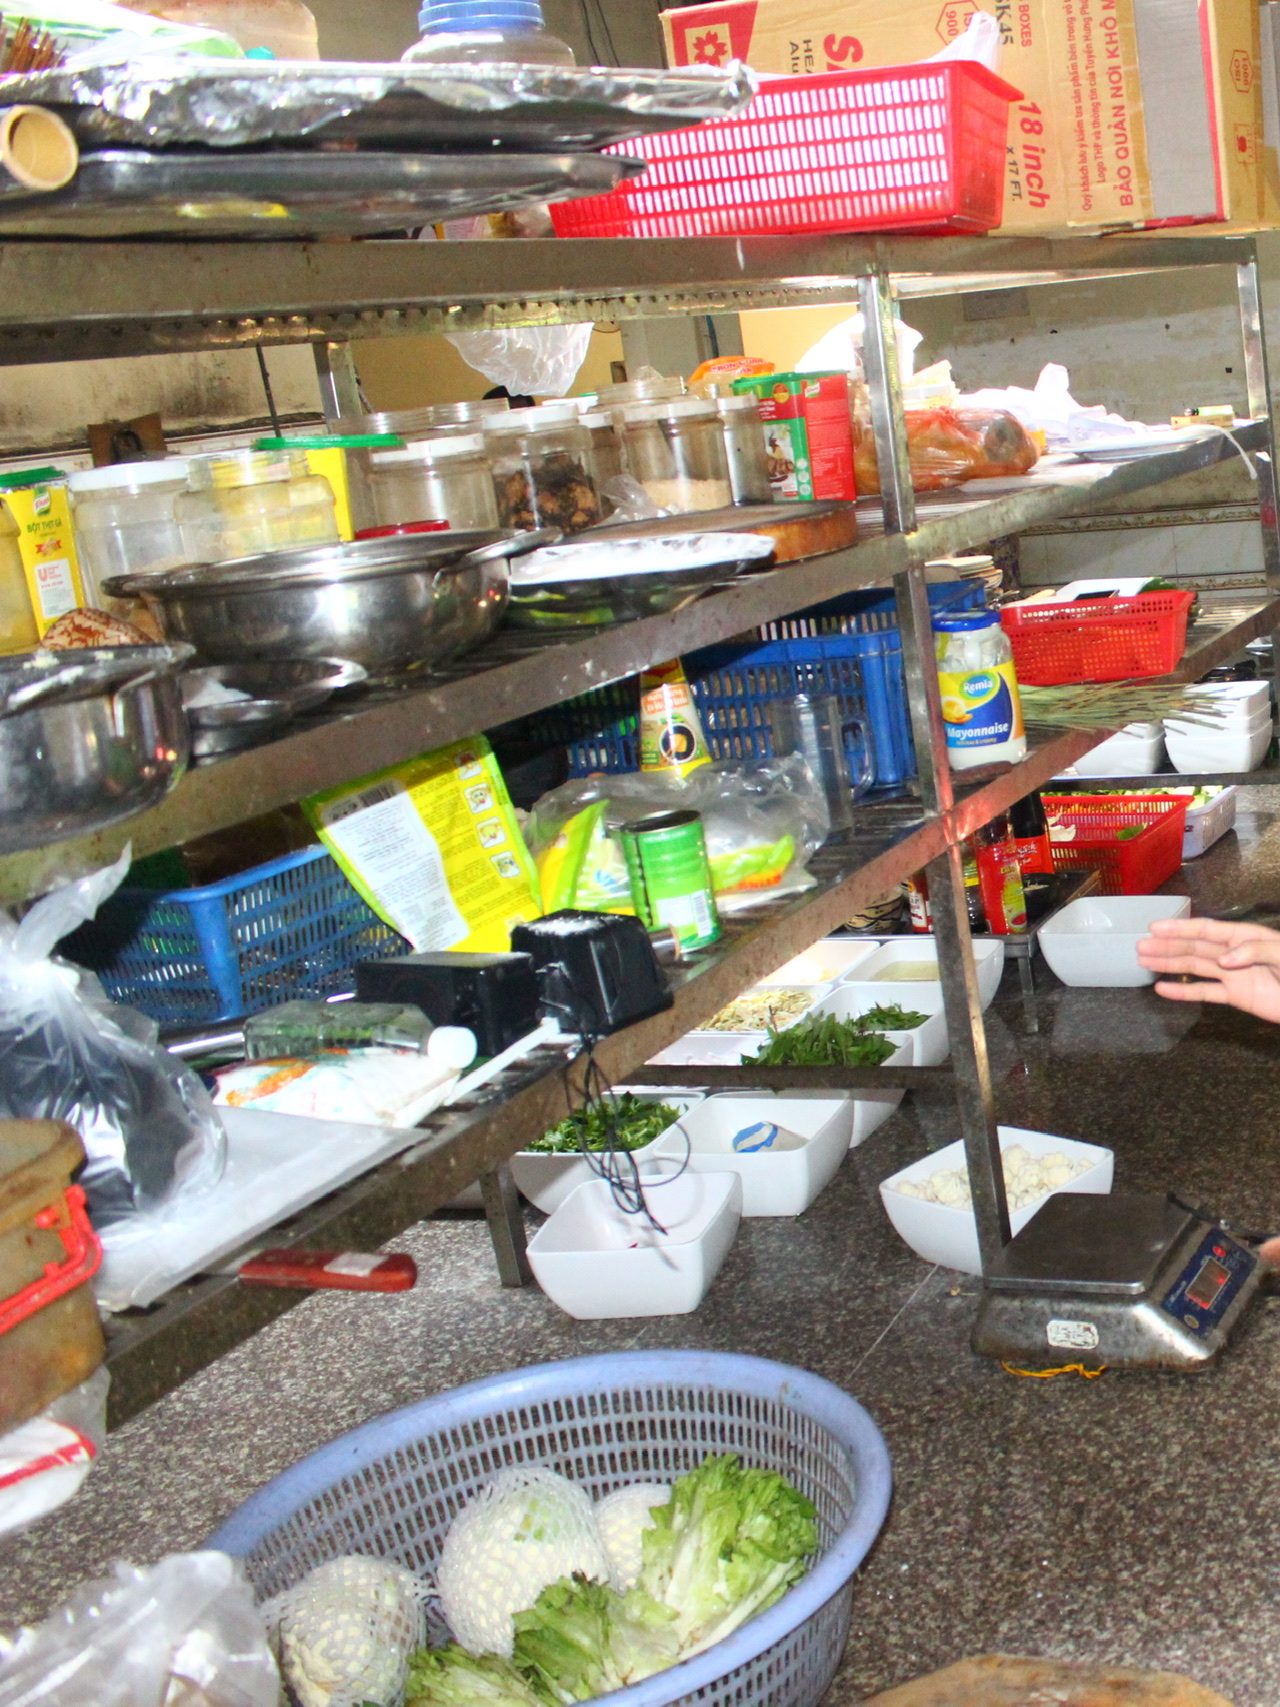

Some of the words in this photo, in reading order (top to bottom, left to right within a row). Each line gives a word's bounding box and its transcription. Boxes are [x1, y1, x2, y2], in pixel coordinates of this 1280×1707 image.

[1018, 4, 1032, 47] BOXES
[1066, 17, 1077, 41] trong
[1099, 16, 1120, 59] KHÔ
[1089, 88, 1098, 100] tin
[1106, 65, 1125, 99] NƠI
[1018, 102, 1043, 136] 18
[1107, 105, 1130, 160] QUẢN
[1008, 160, 1019, 175] 17
[1022, 144, 1051, 208] inch
[1080, 165, 1091, 193] khách
[1097, 161, 1107, 183] Logo
[1112, 165, 1134, 206] BẢO
[964, 680, 993, 694] Remia
[946, 722, 1009, 741] Mayonnaise
